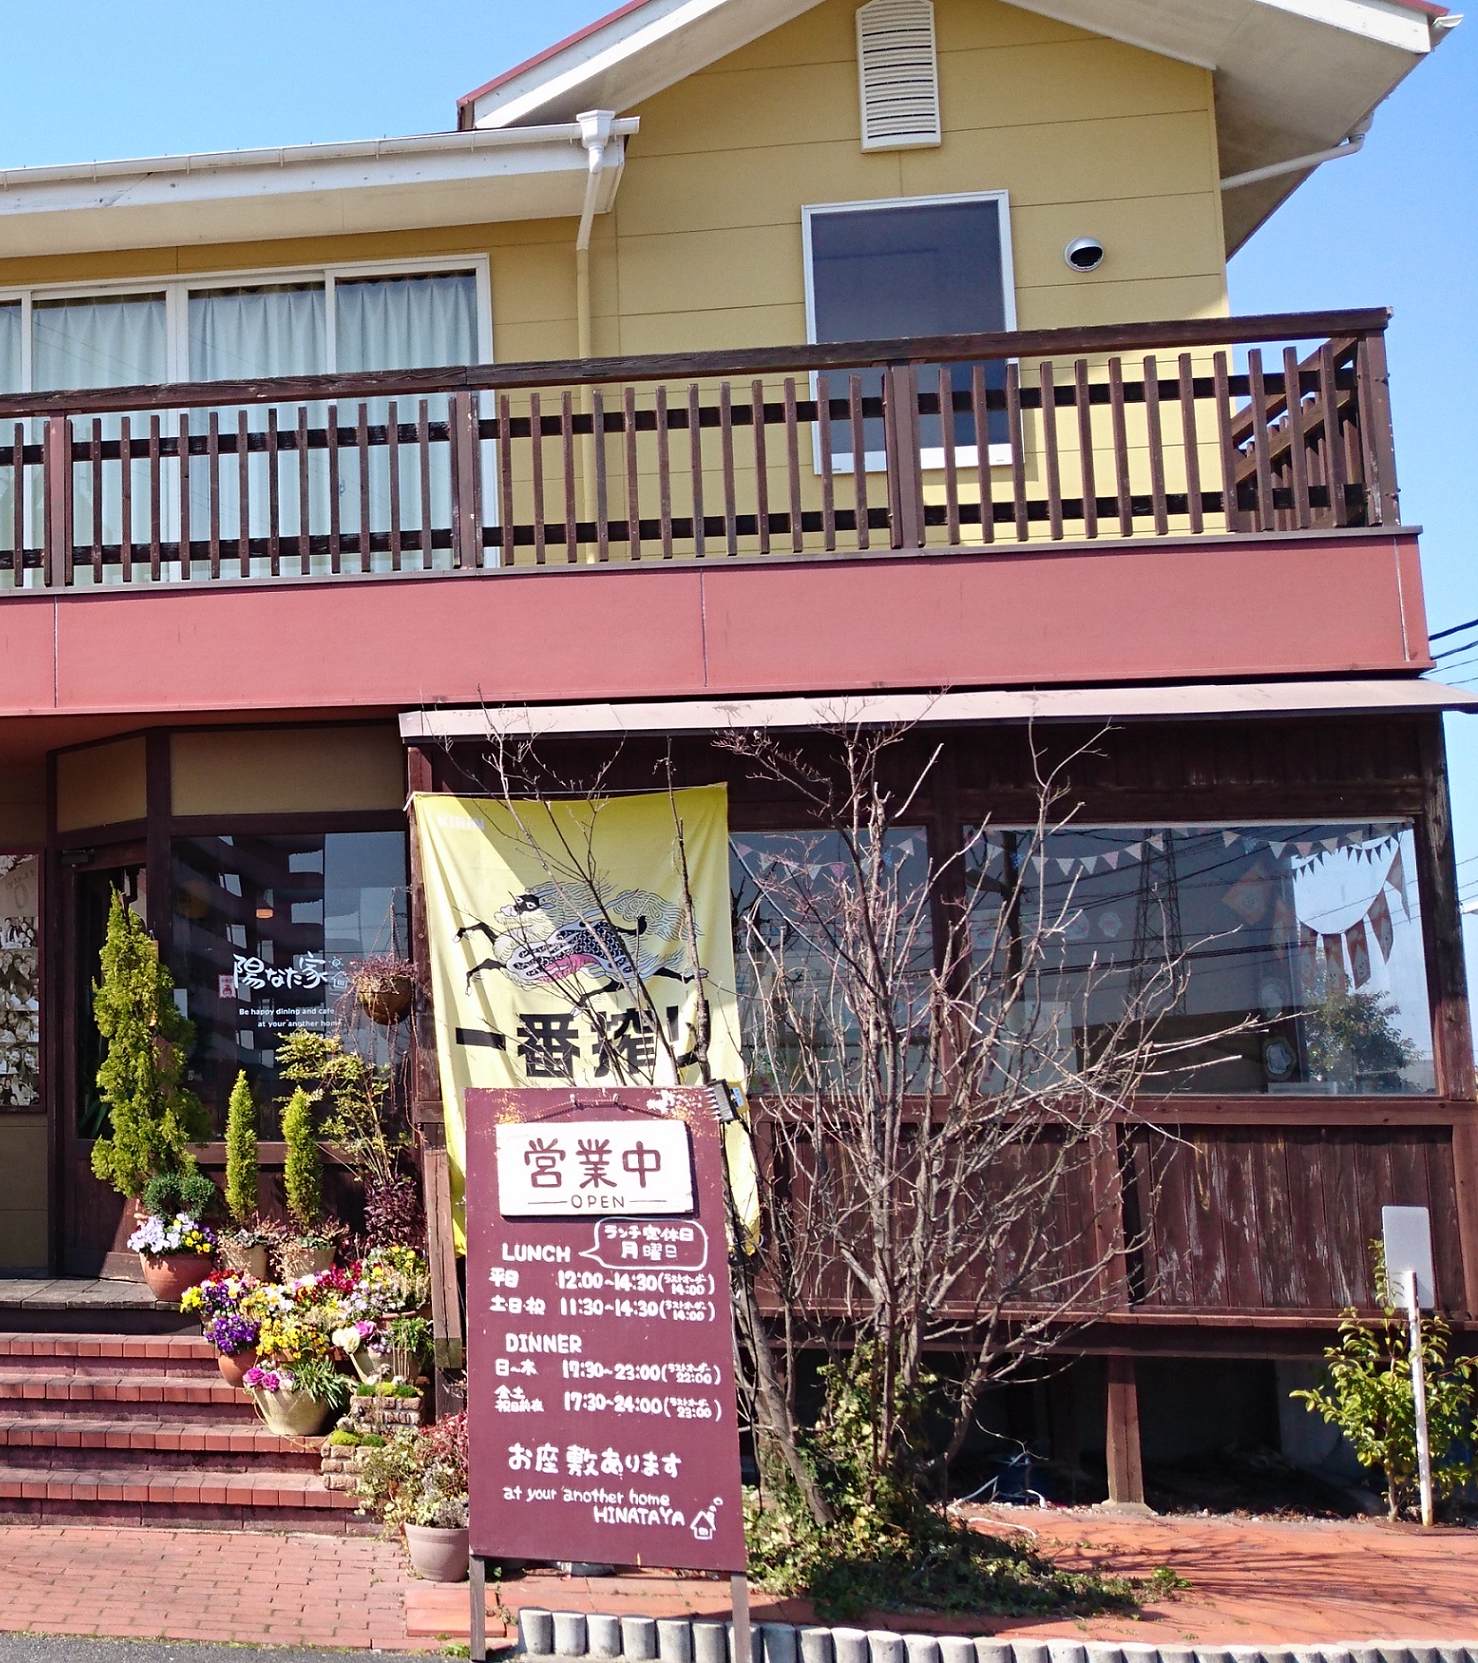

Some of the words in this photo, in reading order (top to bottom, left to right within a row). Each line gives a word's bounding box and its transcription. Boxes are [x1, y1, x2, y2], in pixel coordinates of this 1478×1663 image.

[436, 815, 485, 831] KIRIN
[233, 950, 328, 990] 陽なた家
[239, 1008, 250, 1016] Be
[251, 1008, 274, 1018] happy
[275, 1007, 300, 1017] dining
[301, 1008, 316, 1016] and
[268, 1021, 287, 1029] your
[287, 1020, 319, 1028] another
[524, 1138, 661, 1189] 営業中
[571, 1194, 625, 1209] OPEN
[604, 1225, 694, 1242] ランチ定休日
[502, 1243, 571, 1262] LUNCH
[621, 1241, 677, 1261] 月曜日
[489, 1267, 519, 1288] 平日
[505, 1333, 582, 1353] DINNER
[508, 1442, 682, 1478] お座敷あります
[502, 1485, 523, 1501] at
[526, 1487, 558, 1503] your
[629, 1488, 671, 1507] home
[593, 1506, 686, 1526] HINATAYA
